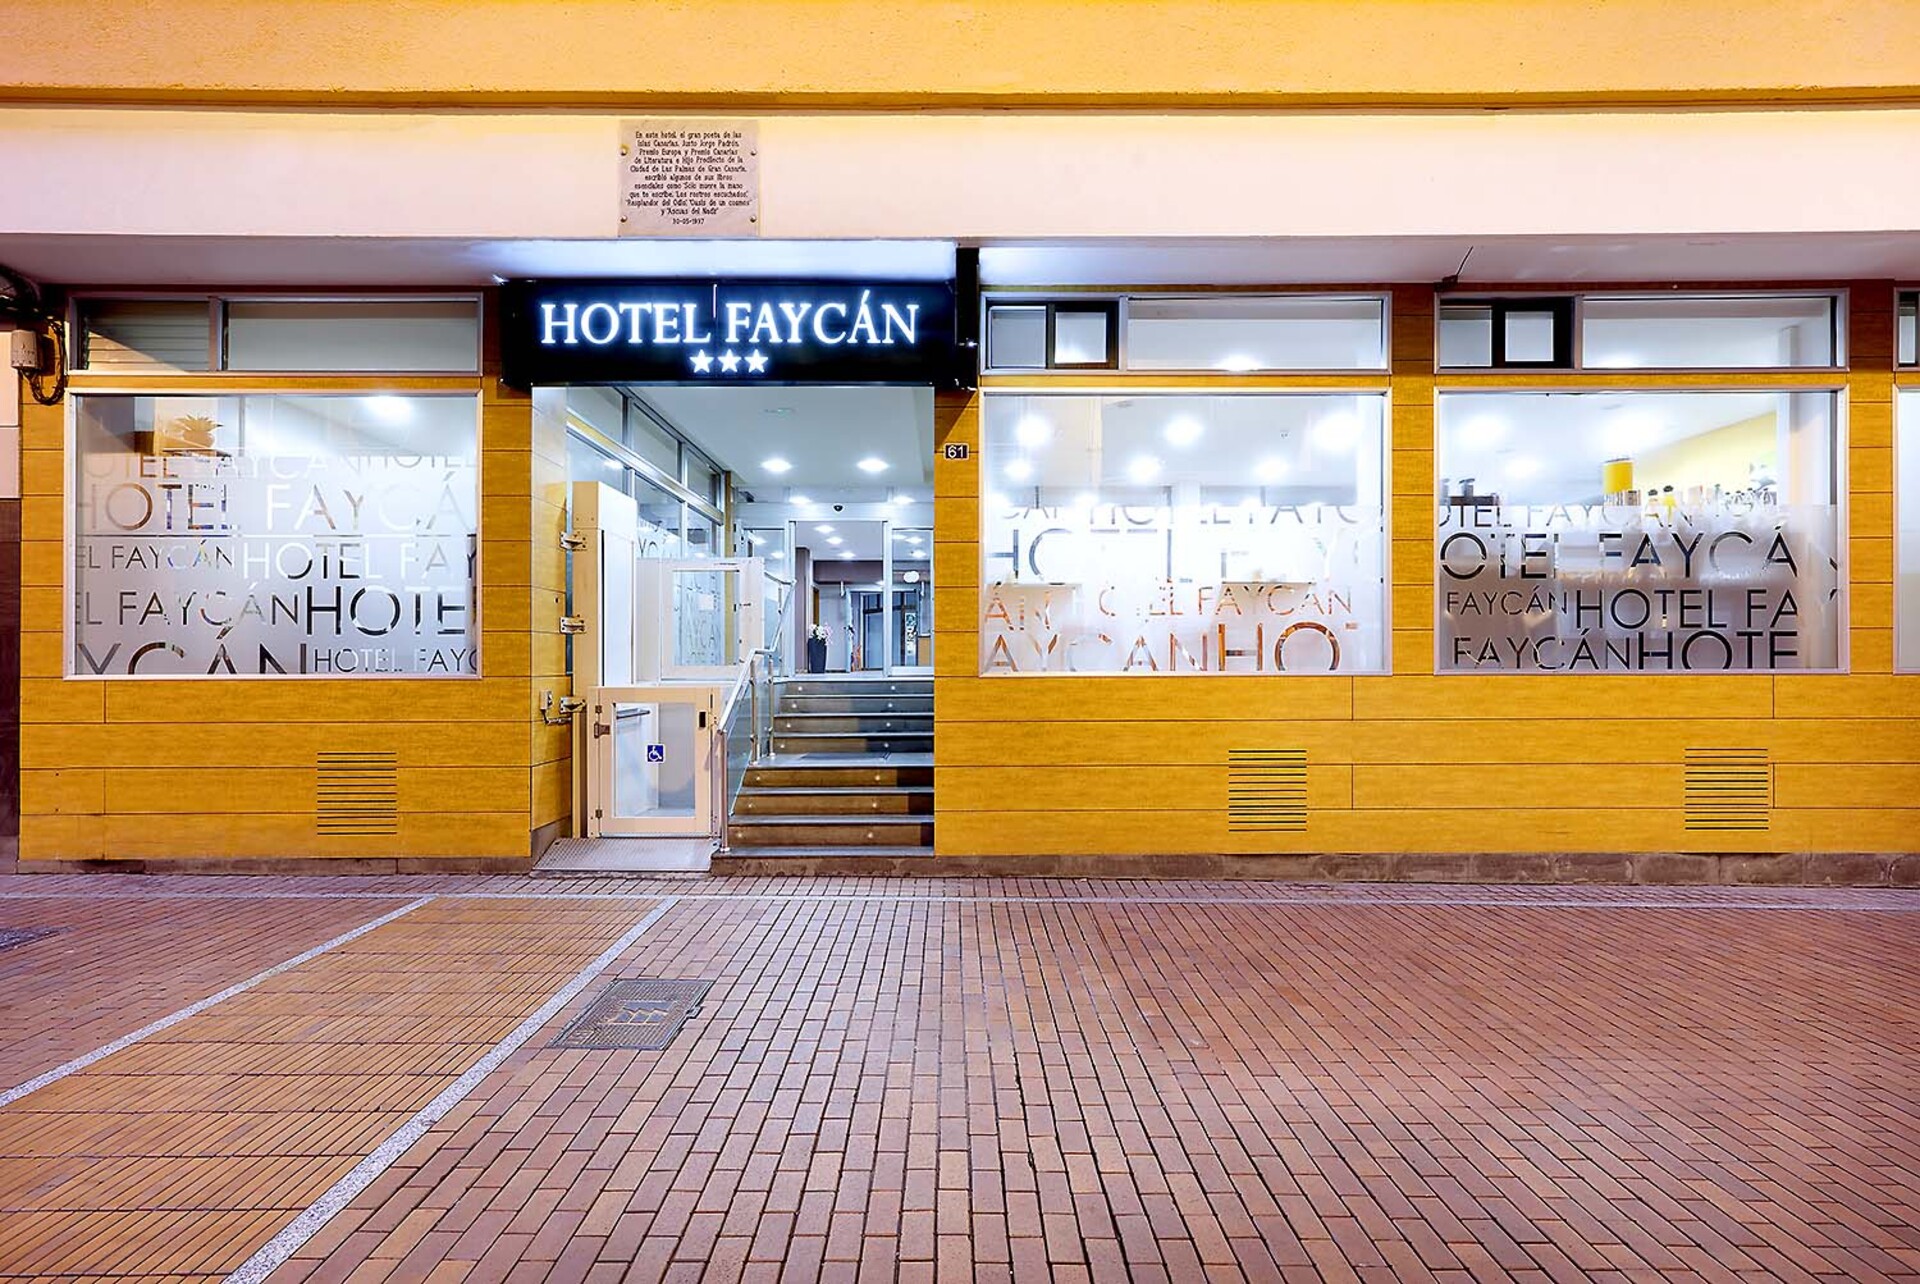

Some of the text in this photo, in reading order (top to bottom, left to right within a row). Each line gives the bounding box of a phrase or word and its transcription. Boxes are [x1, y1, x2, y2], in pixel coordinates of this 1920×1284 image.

[687, 131, 701, 139] gran
[703, 131, 720, 139] poeta
[700, 140, 716, 148] Jorge
[662, 149, 682, 157] Europa
[630, 165, 649, 173] Ciudad
[661, 165, 673, 173] Las
[675, 165, 695, 173] Palmas
[708, 165, 722, 173] Gran
[669, 174, 693, 182] algunos
[629, 191, 640, 199] que
[541, 289, 920, 344] HOTEL FAYCÁN
[948, 445, 964, 459] 61
[242, 541, 383, 581] HOTEL
[1447, 584, 1567, 616] FAYCÁN
[1576, 588, 1728, 630] HOTEL
[1454, 627, 1631, 670] FAYCÁN
[314, 648, 403, 673] HOTEL
